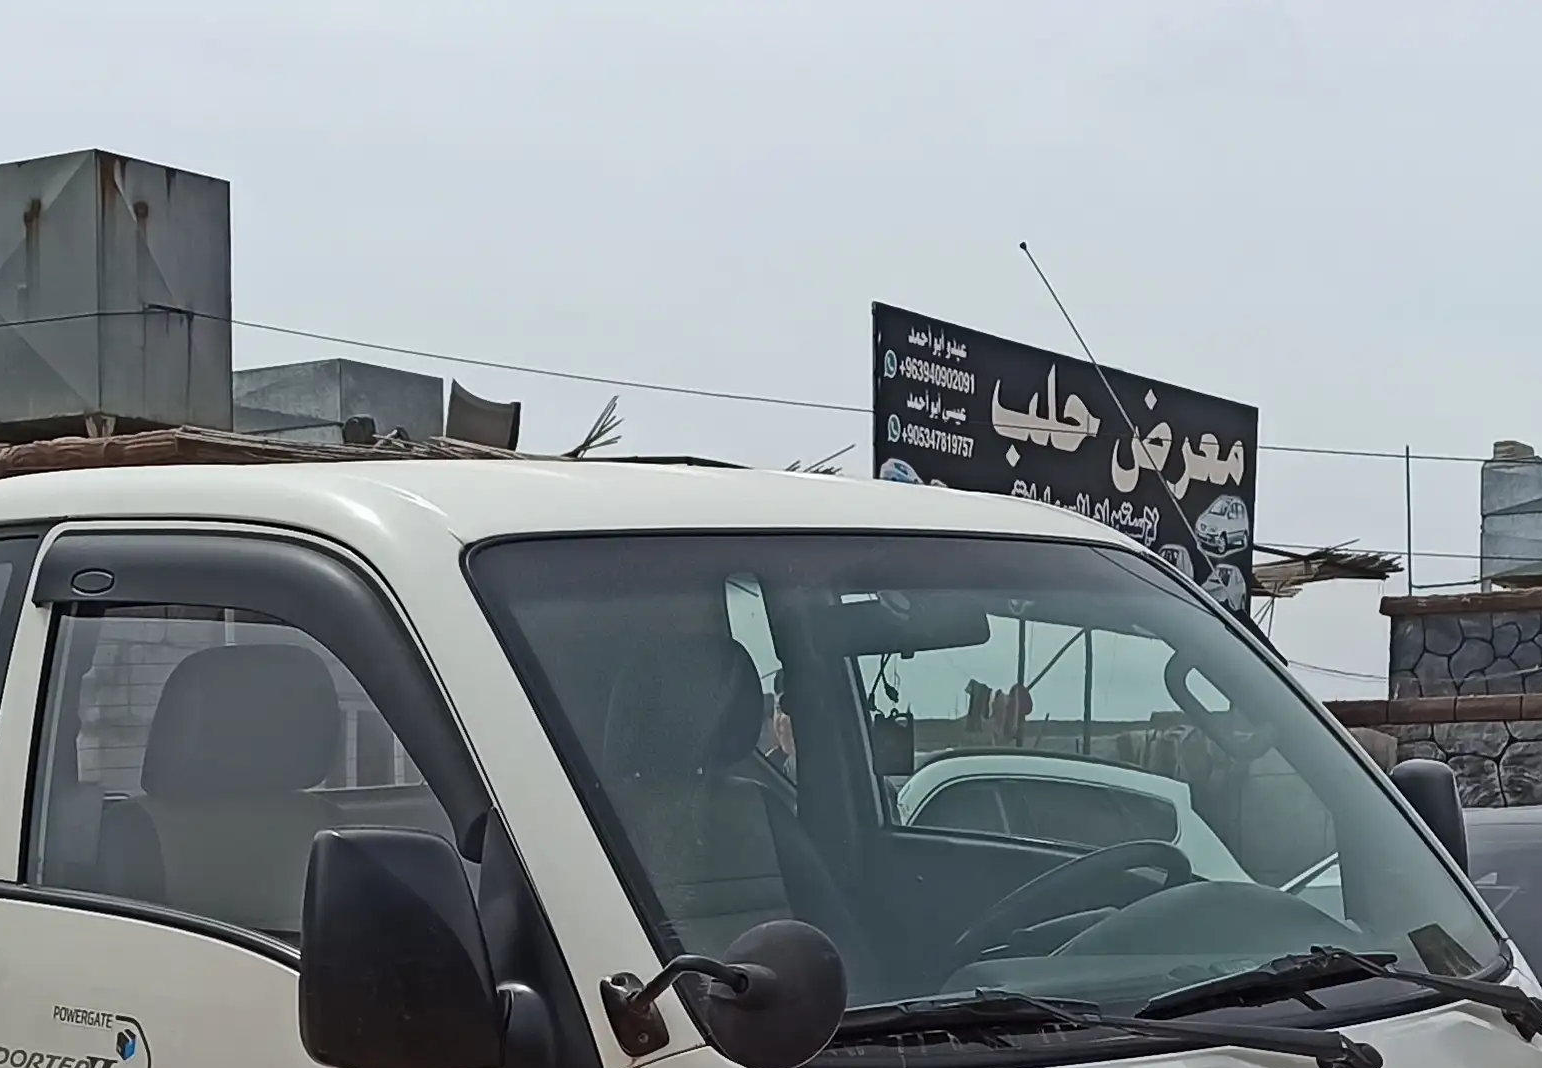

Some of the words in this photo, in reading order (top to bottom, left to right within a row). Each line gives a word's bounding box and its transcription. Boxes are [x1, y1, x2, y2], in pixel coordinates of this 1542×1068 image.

[992, 363, 1101, 467] حلب
[1112, 388, 1244, 501] معرض
[53, 1005, 114, 1028] POWERGATE
